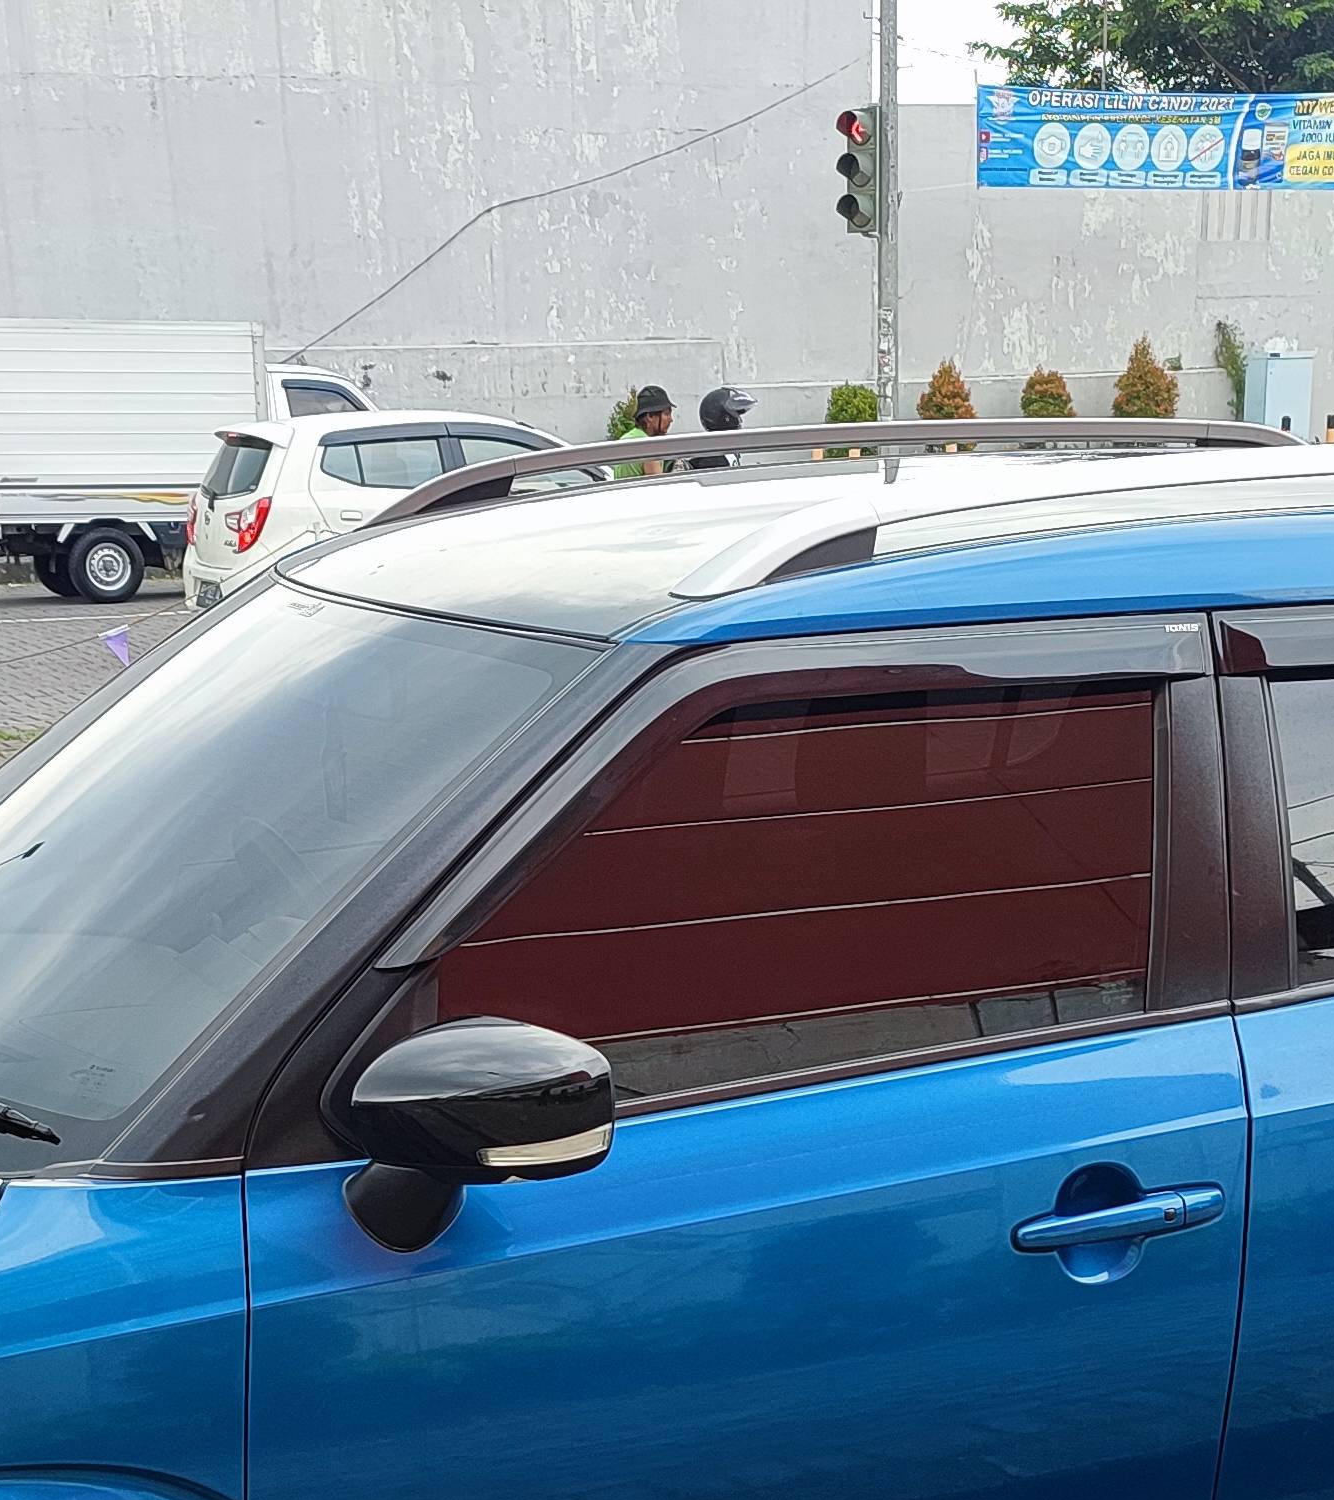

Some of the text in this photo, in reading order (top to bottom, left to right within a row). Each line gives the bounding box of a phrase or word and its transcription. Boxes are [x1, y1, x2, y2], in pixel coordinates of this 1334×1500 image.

[1028, 90, 1235, 111] OPERASI LILIN CANDI 2021
[1296, 150, 1321, 161] JAGA
